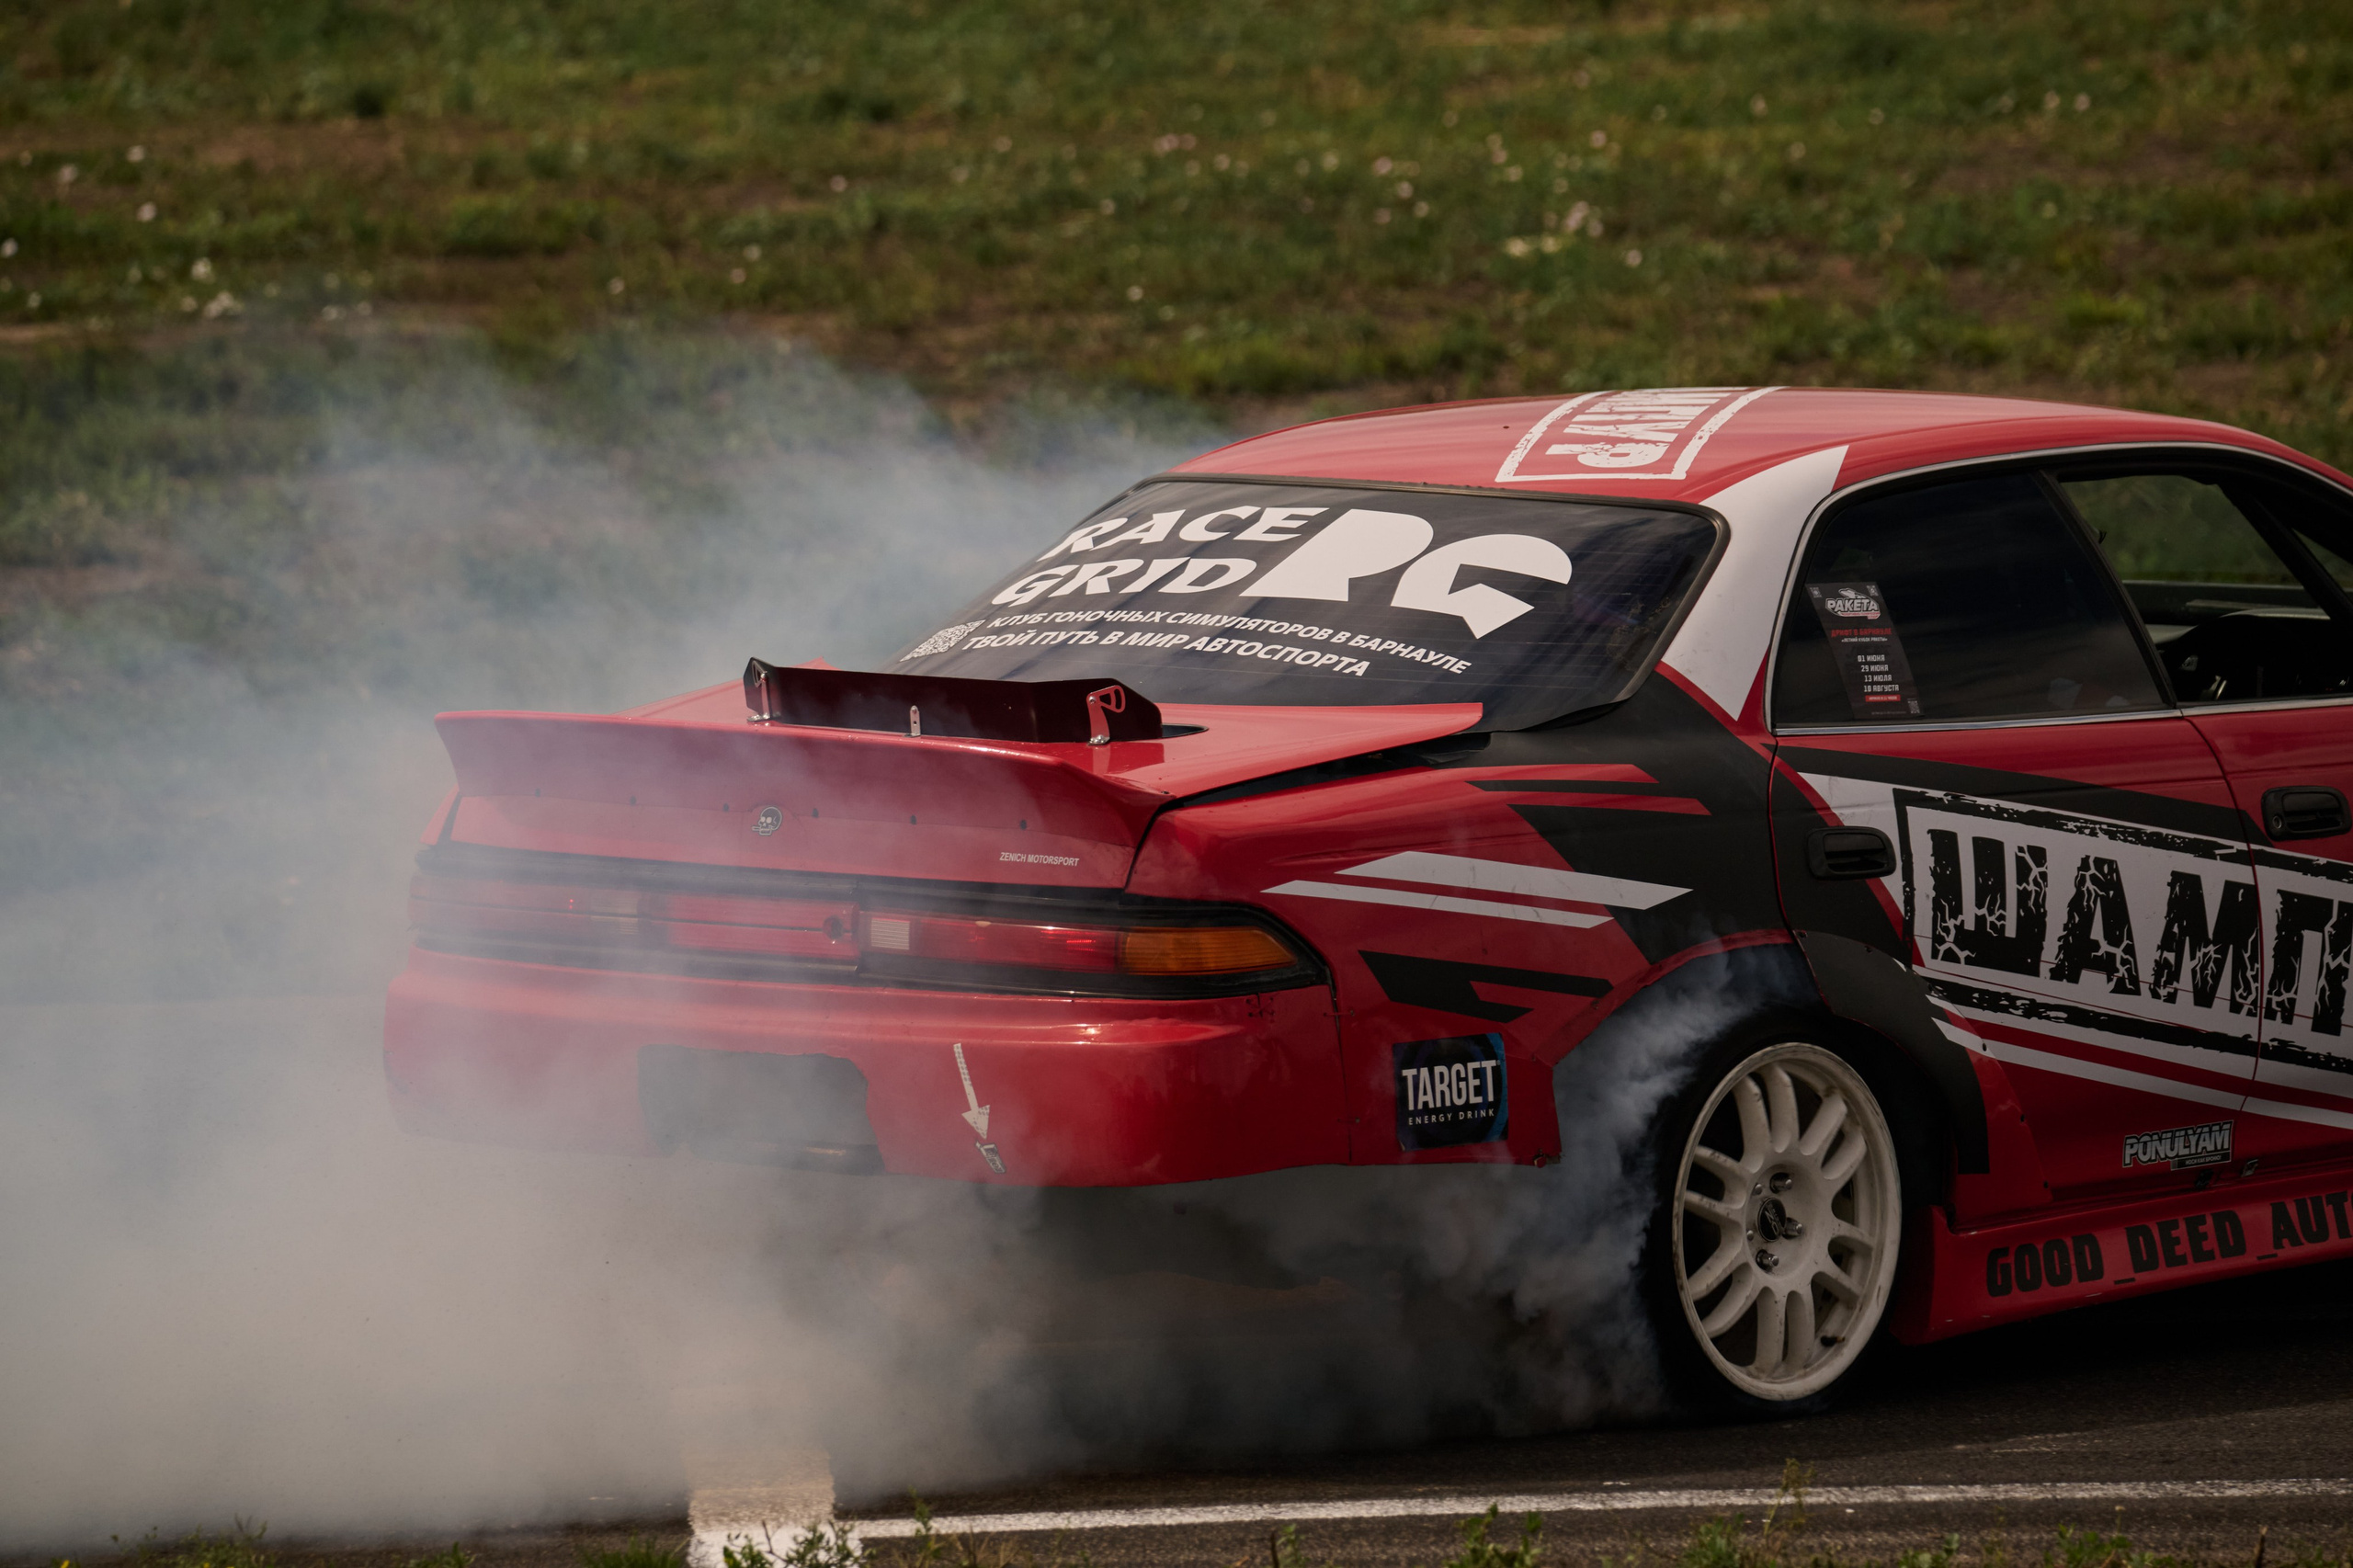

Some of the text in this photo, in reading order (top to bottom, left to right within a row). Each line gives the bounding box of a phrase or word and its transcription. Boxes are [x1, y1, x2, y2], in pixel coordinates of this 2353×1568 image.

[1036, 506, 1330, 562] RACE
[991, 556, 1257, 608] GRID
[1827, 598, 1879, 612] РАКЕТА
[962, 630, 1370, 677] ТВОЙ ПУТЬ В МИР АВТОСПОРТА
[986, 610, 1472, 675] КЛУБ ГОНОЧНЫХ СИМУЛЯТОРОВ В БАРНАУЛЕ
[999, 852, 1080, 867] ZENICH MOTORSPORT
[1402, 1060, 1496, 1111] TARGET
[1408, 1108, 1495, 1126] ENERGY DRINK
[2124, 1121, 2233, 1165] PONULYAM
[1986, 1189, 2353, 1297] GOOD_DEED_AUT
